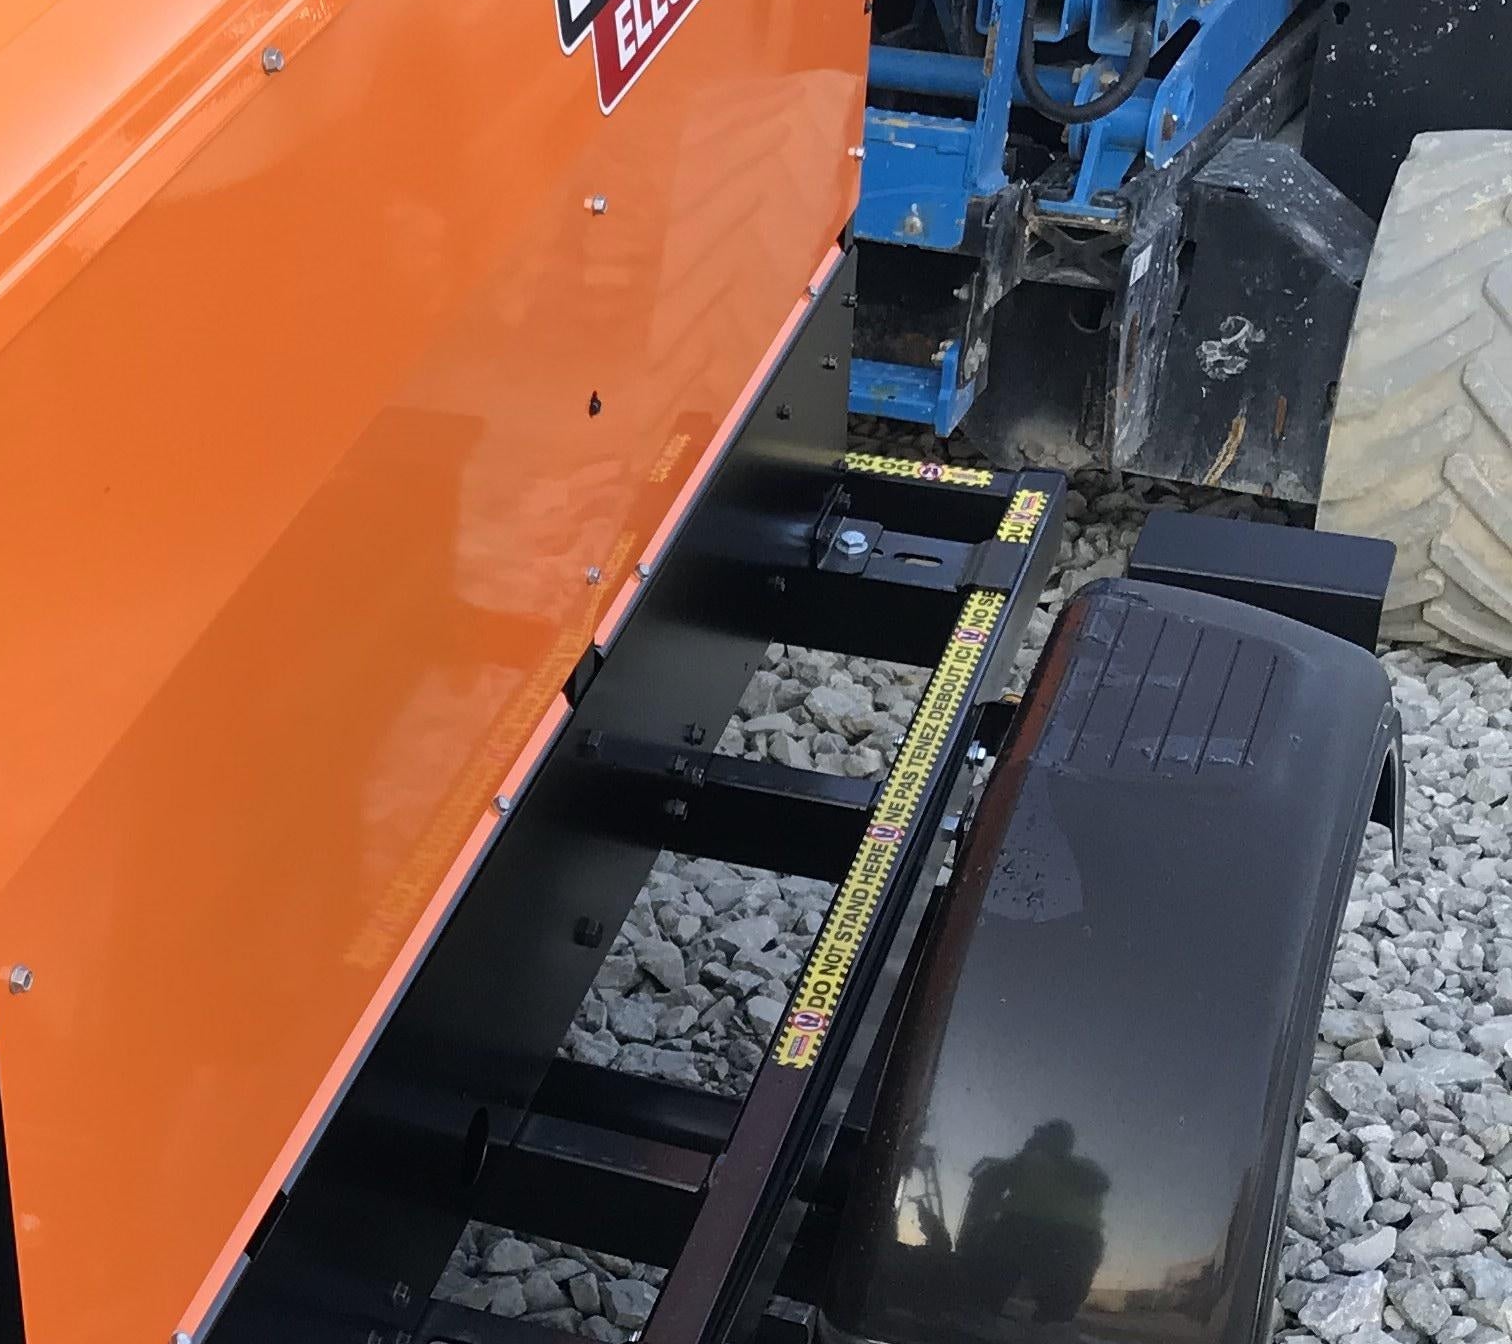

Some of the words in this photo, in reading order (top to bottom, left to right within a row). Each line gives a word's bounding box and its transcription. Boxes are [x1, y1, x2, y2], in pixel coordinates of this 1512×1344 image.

[968, 608, 989, 628] NO
[954, 645, 974, 665] ICI
[927, 665, 965, 721] DEBOUT
[907, 722, 939, 771] TENEZ
[894, 770, 920, 803] PAS
[883, 801, 906, 823] NE
[859, 842, 889, 886] HERE
[834, 887, 870, 943] STAND
[818, 943, 847, 977] NOT
[807, 980, 831, 1010] DO
